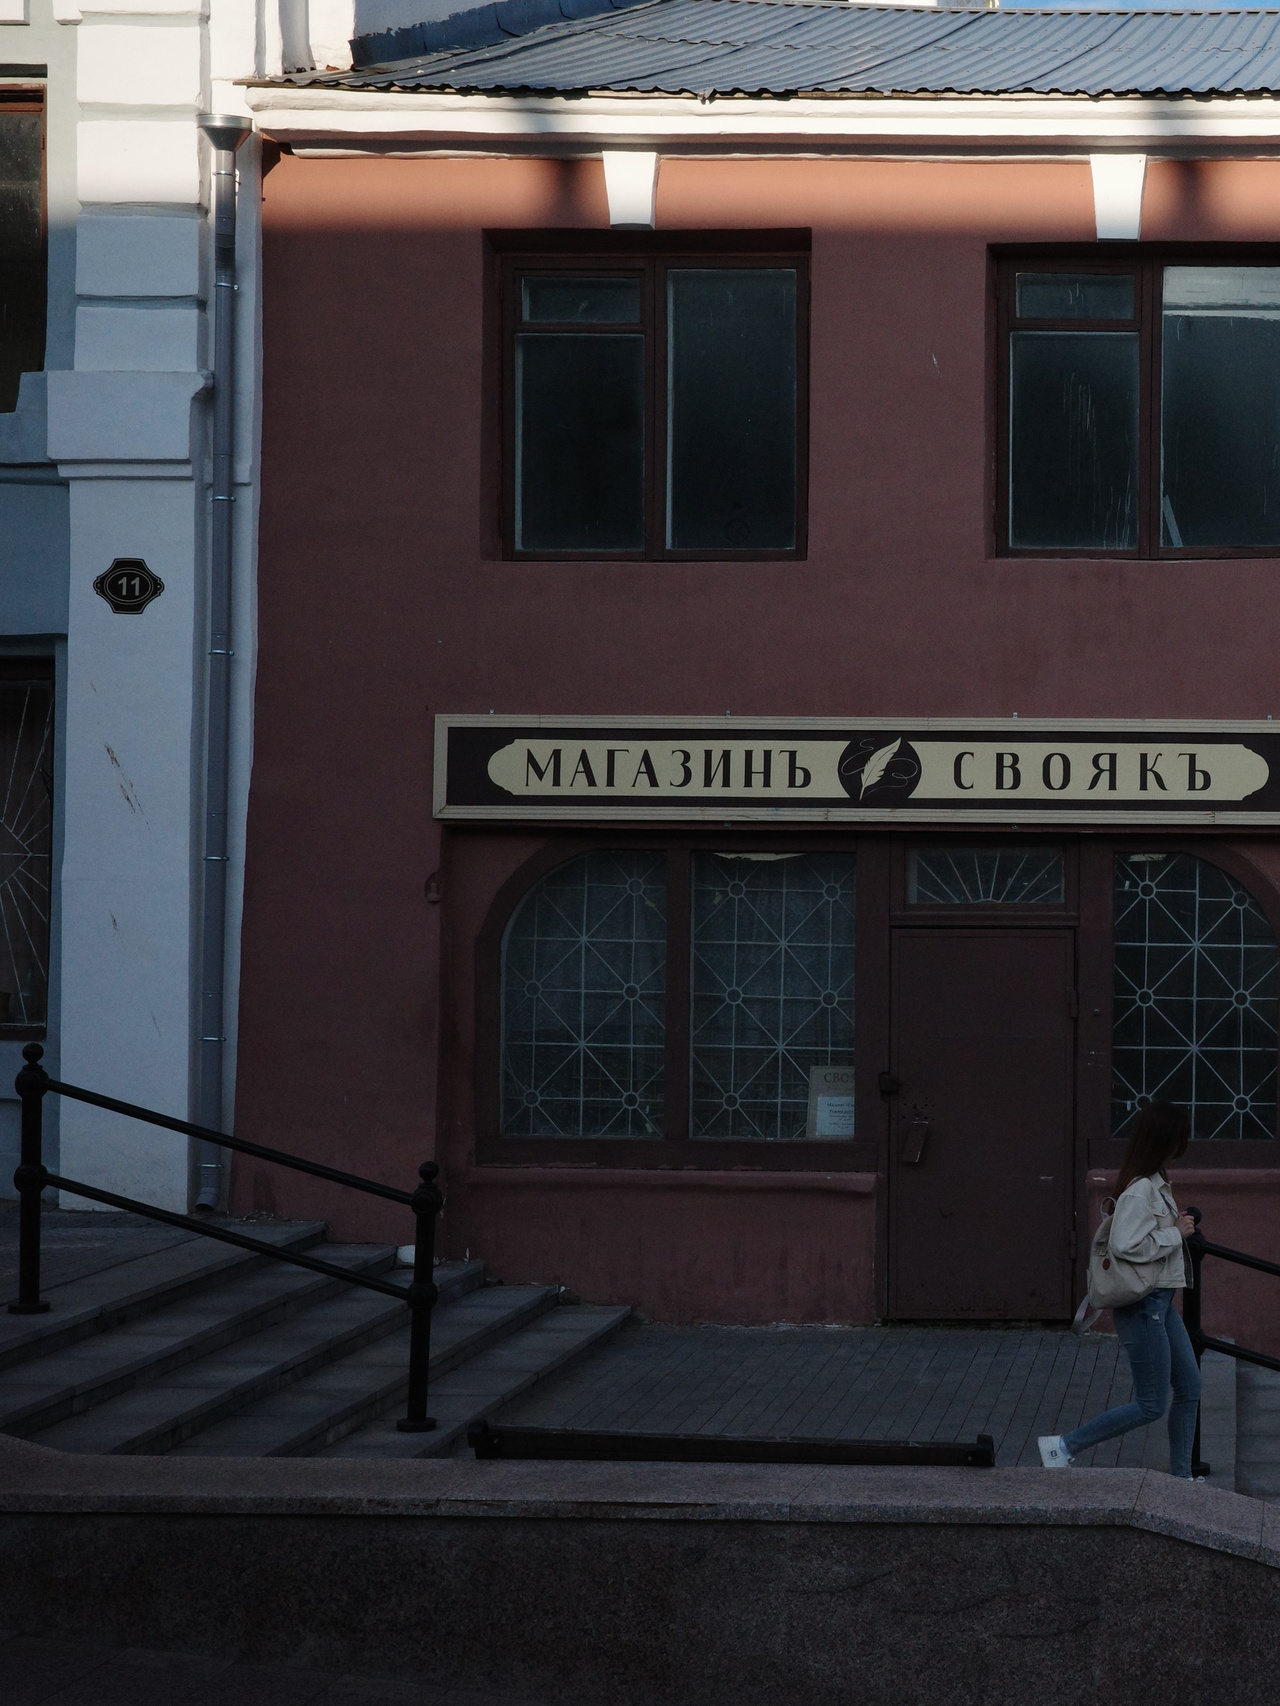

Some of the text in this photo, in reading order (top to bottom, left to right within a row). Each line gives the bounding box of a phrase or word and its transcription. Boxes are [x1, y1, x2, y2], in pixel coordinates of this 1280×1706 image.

[117, 576, 141, 596] 11
[524, 747, 1212, 791] МАГАЗИНЪ СВОЯКЪ
